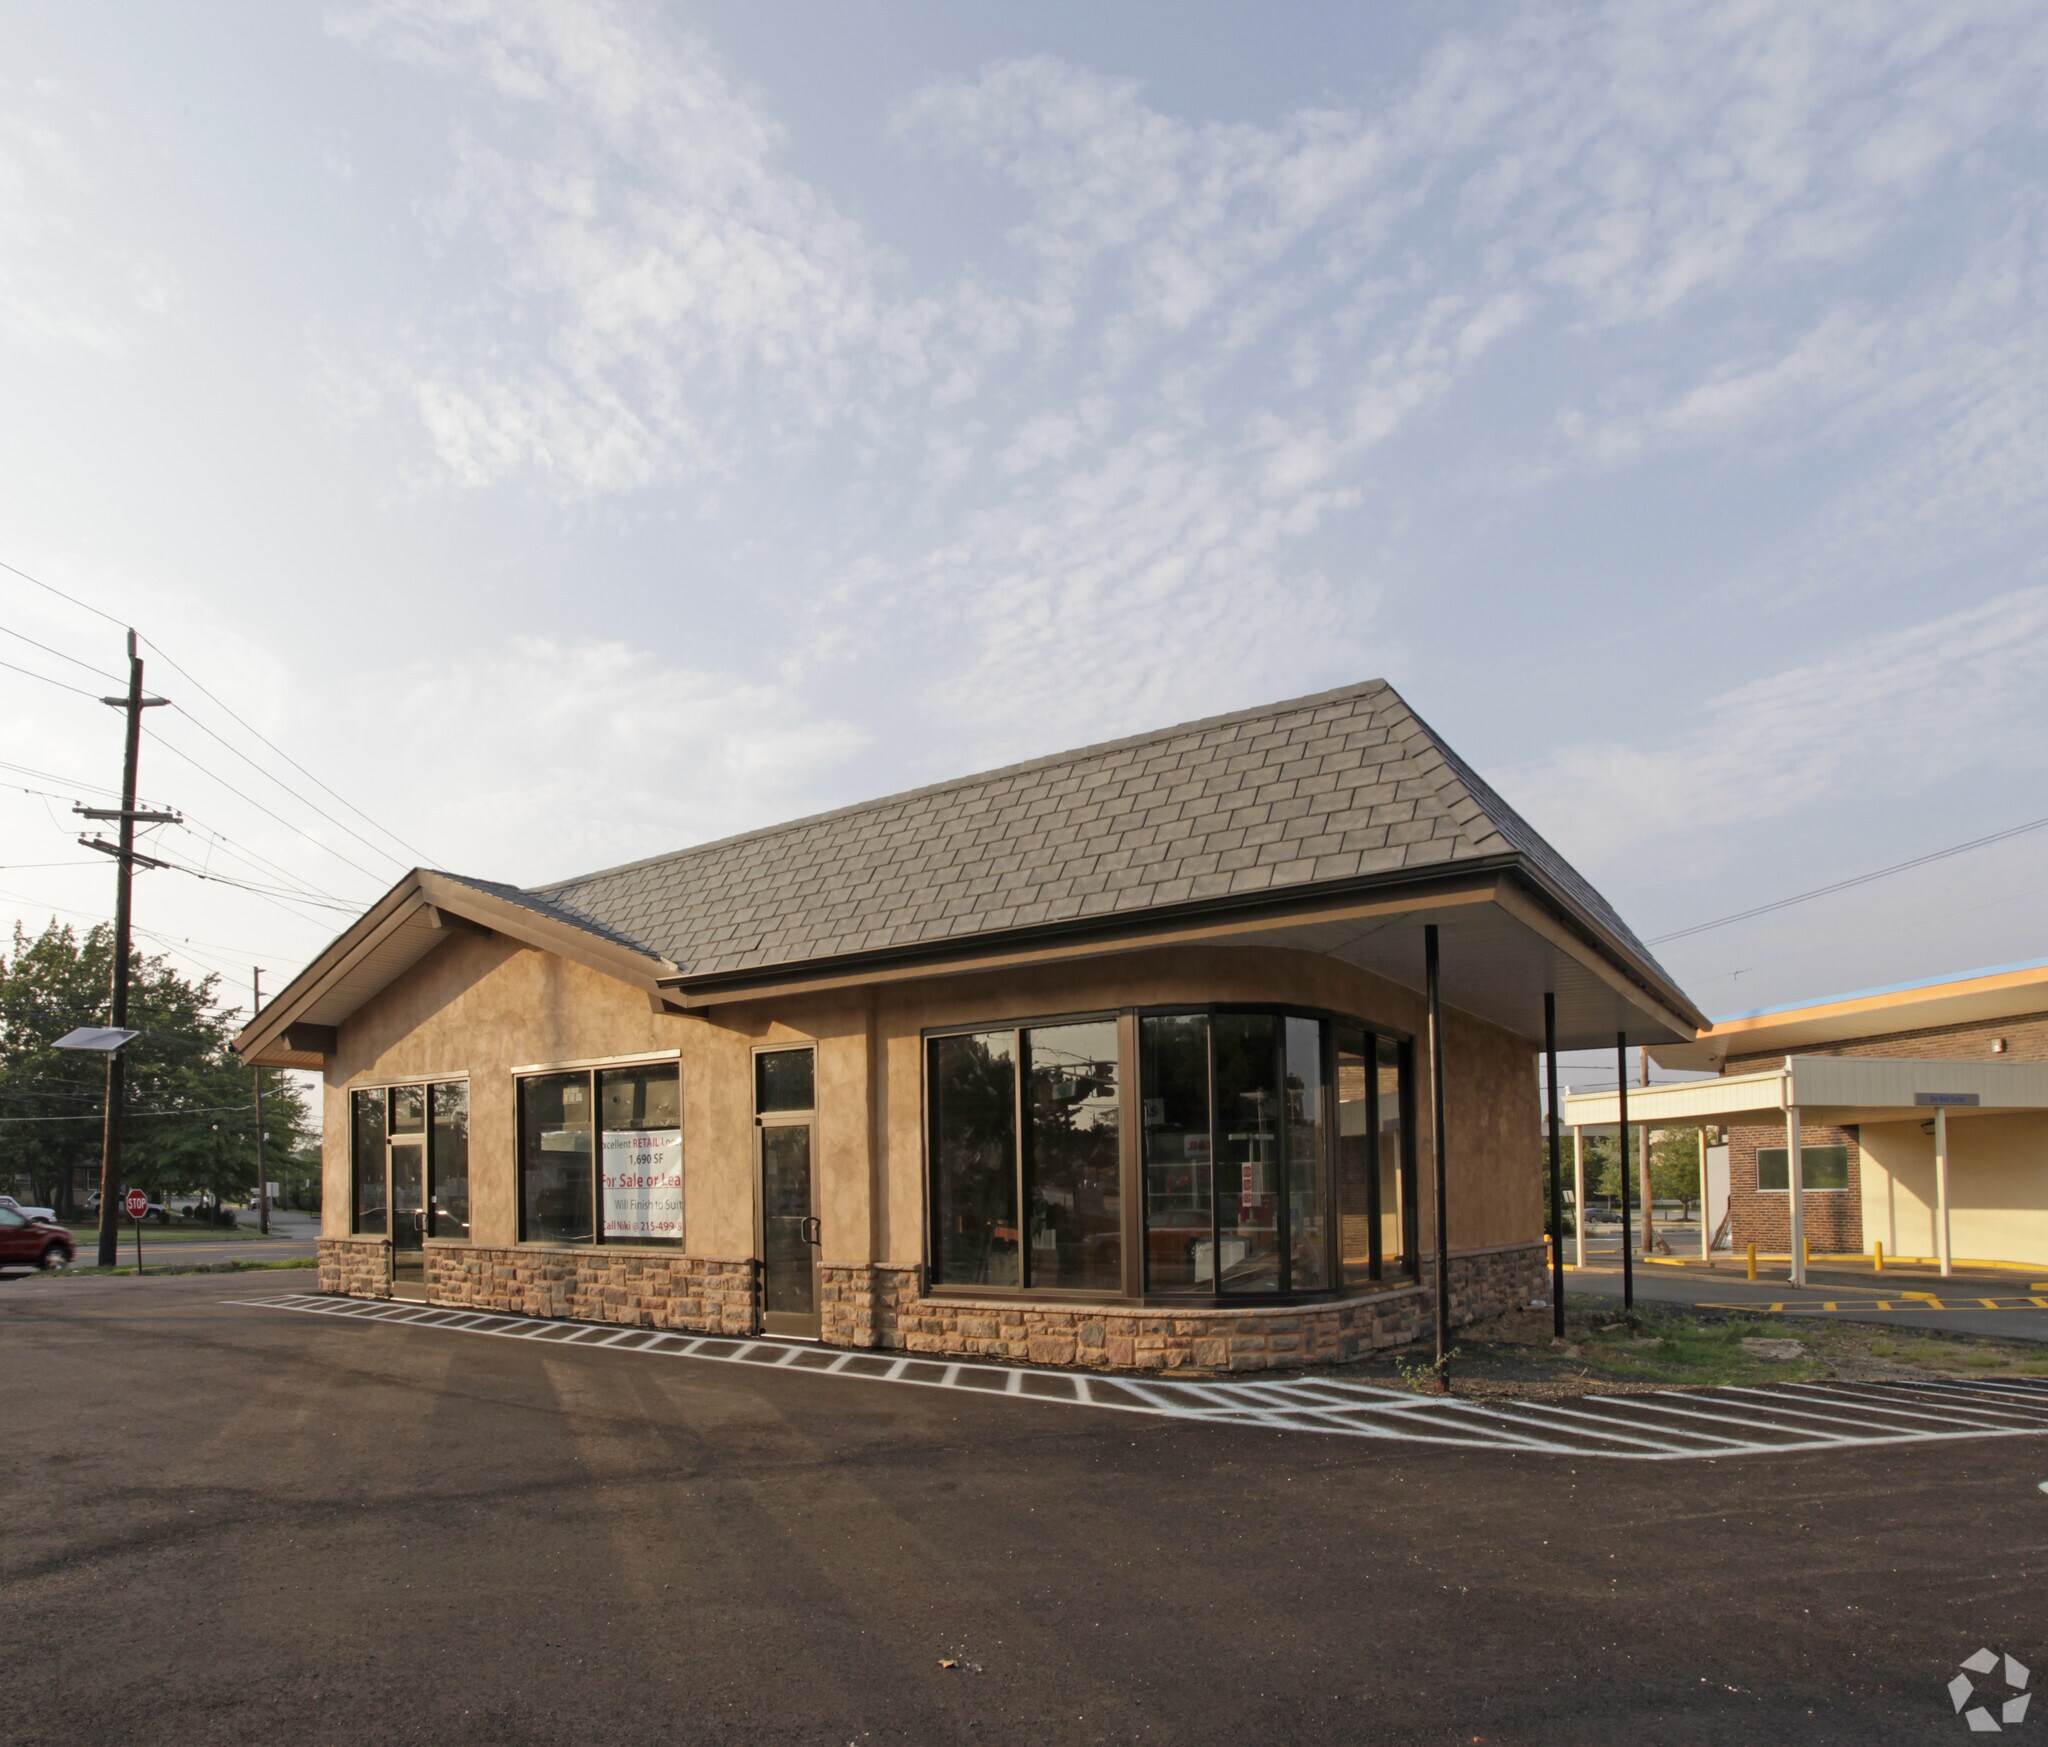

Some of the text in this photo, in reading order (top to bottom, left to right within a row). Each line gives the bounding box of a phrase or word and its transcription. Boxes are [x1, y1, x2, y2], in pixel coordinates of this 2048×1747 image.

[602, 1139, 631, 1150] xcellent
[632, 1137, 659, 1148] RETAIL
[629, 1153, 664, 1166] 1,690 SF
[619, 1172, 643, 1187] Sale
[646, 1176, 659, 1187] or
[128, 1198, 146, 1209] STOP
[615, 1199, 683, 1210] Will Finish to Suit
[617, 1221, 631, 1231] Niki
